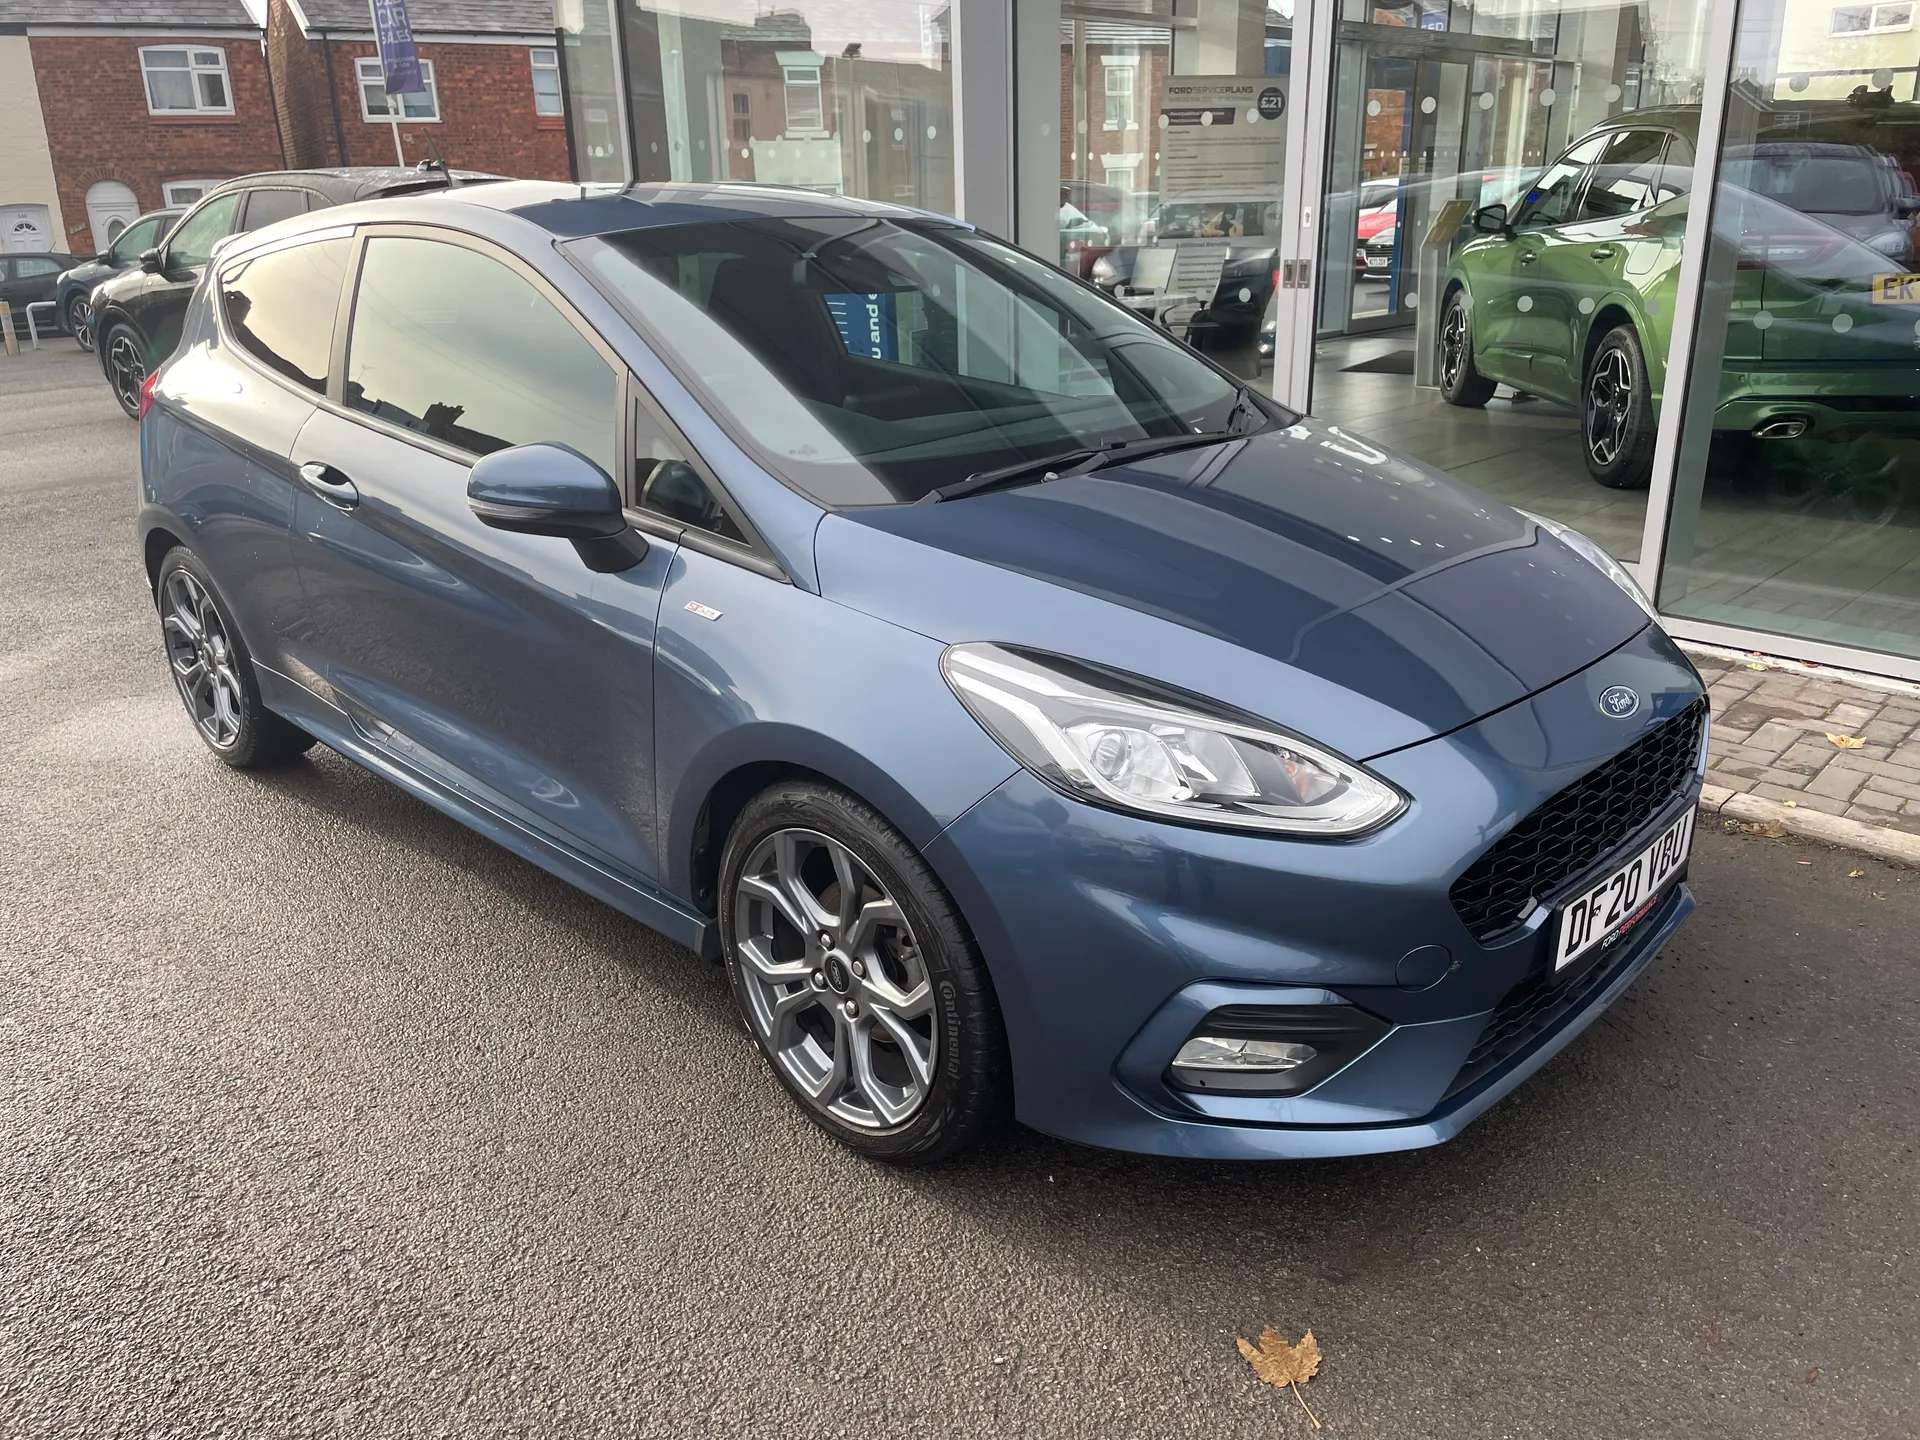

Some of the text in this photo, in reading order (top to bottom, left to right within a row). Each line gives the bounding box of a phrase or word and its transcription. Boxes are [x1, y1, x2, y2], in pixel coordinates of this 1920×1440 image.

[378, 7, 408, 28] CAR
[381, 29, 411, 44] SALES
[1260, 96, 1282, 109] £21
[866, 303, 880, 343] and
[1607, 692, 1633, 713] Ford
[1544, 813, 1689, 958] DF20 VBU
